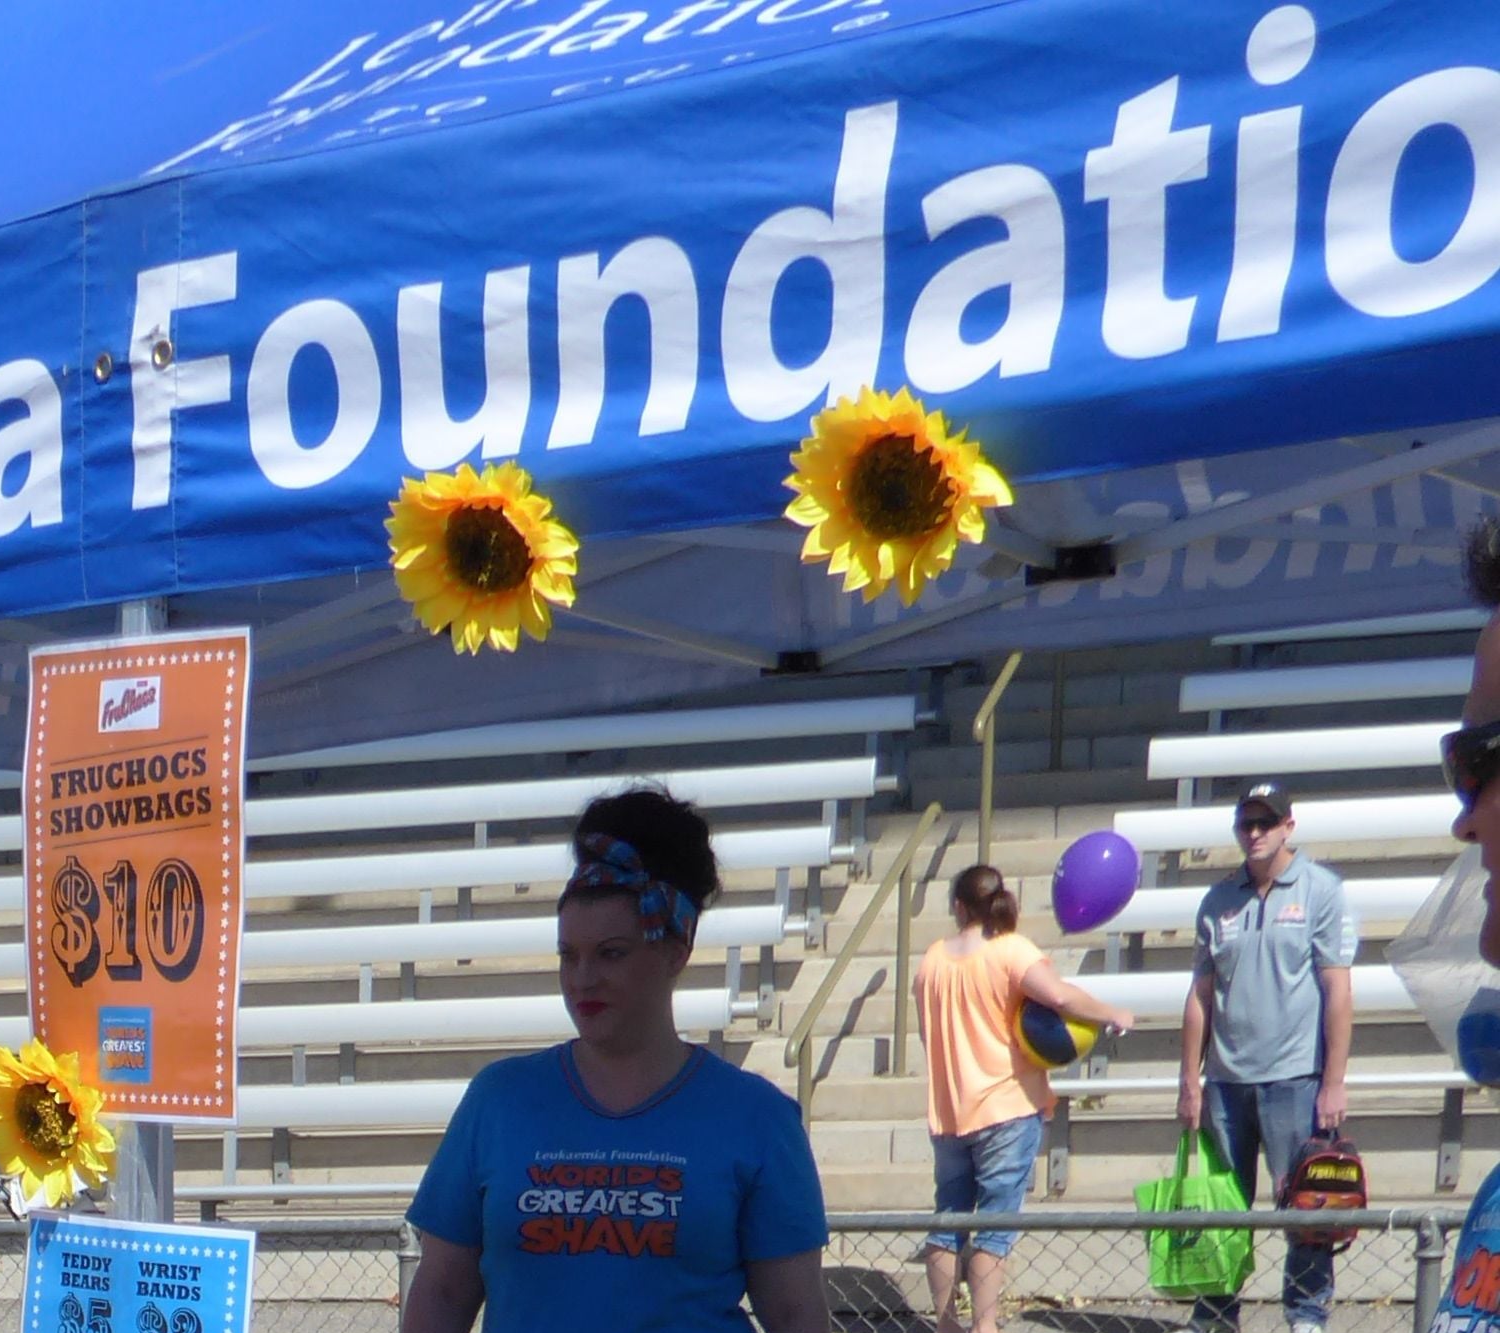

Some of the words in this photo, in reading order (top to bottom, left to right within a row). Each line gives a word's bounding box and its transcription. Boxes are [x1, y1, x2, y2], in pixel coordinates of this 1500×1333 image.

[129, 5, 1500, 510] Foundatio
[50, 747, 208, 799] FRUCHOCS
[50, 786, 212, 836] SHOWBAGS
[50, 855, 205, 987] $10
[534, 1148, 607, 1163] Leukaemia
[610, 1149, 688, 1165] Foundation
[528, 1163, 683, 1192] WORLD'S
[517, 1189, 683, 1218] GREATEST
[517, 1217, 678, 1258] SHAVE
[61, 1252, 112, 1273] TEDDY
[138, 1260, 202, 1282] WRIST
[60, 1272, 111, 1292] BEARS
[136, 1280, 202, 1301] BANDS
